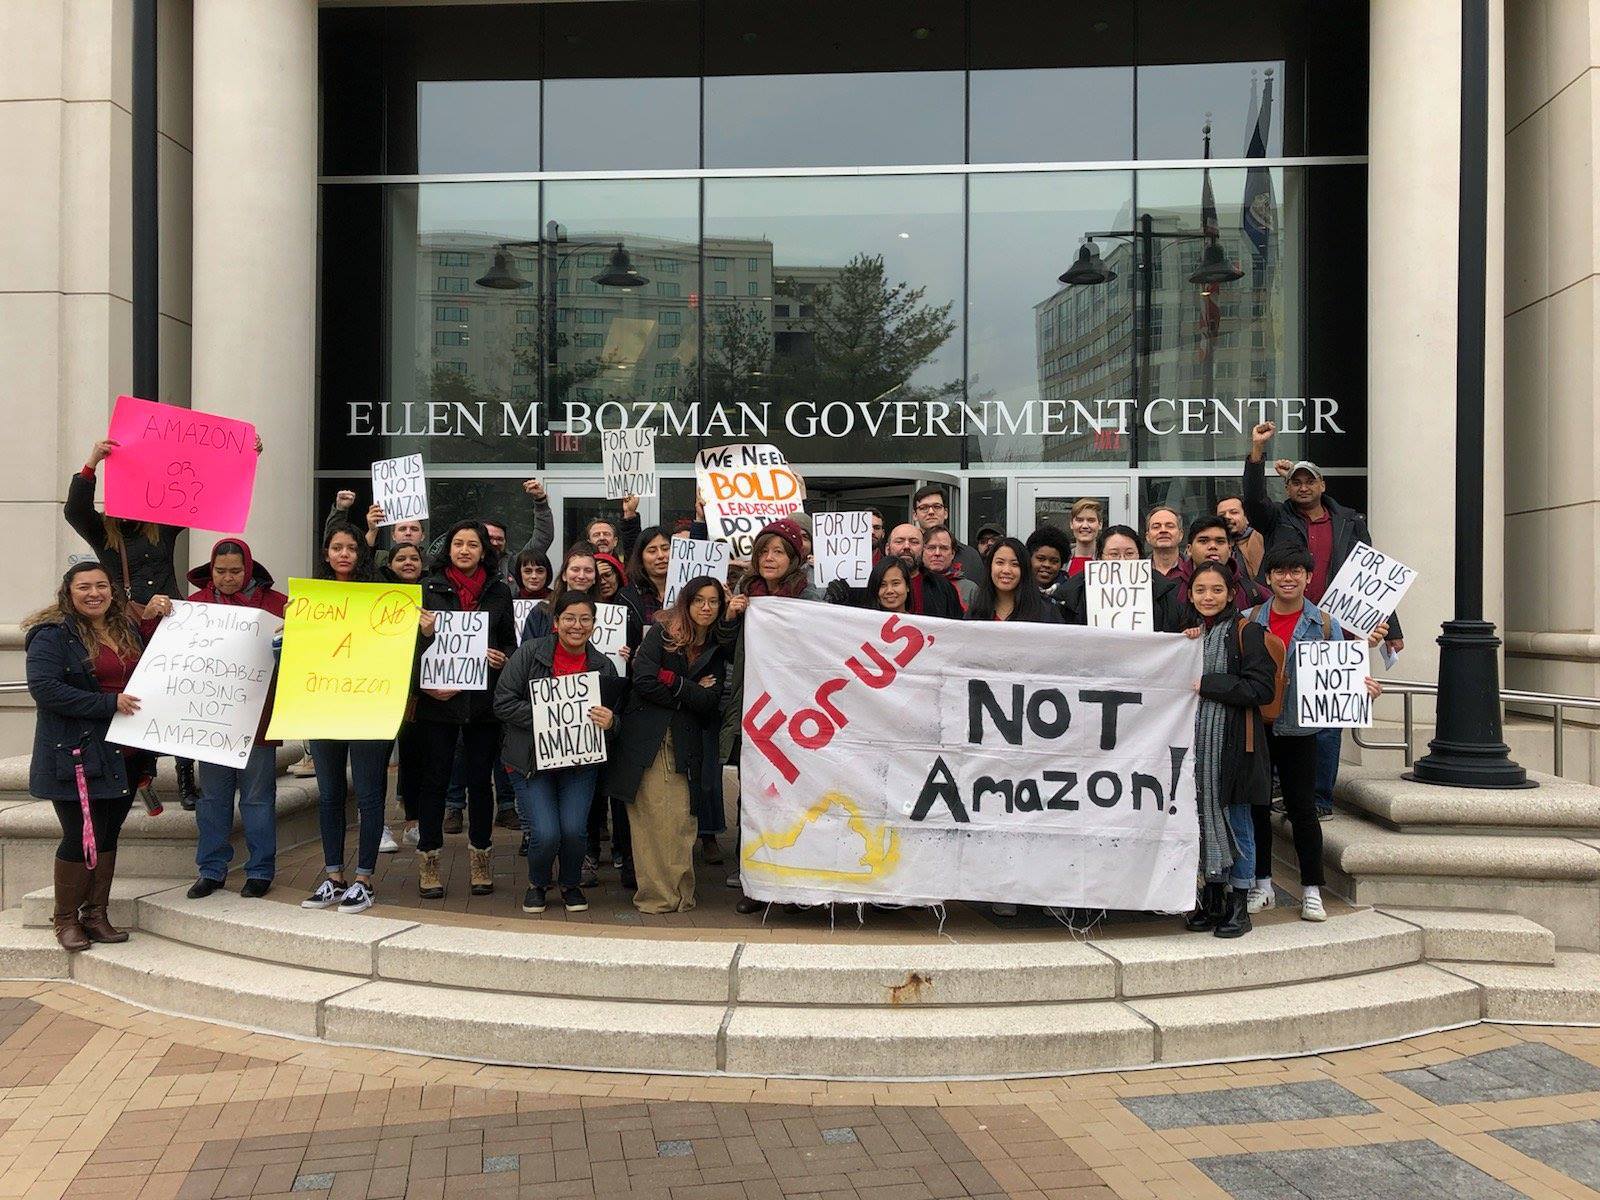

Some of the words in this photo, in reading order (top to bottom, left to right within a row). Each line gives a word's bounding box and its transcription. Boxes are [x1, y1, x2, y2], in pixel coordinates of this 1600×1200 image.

[346, 401, 487, 436] ELLEN
[500, 401, 550, 437] M.
[562, 401, 772, 437] BOZMAN
[785, 399, 1138, 437] GOVERNMENT
[1143, 397, 1346, 436] CENTER
[142, 415, 247, 454] AMAZON
[603, 430, 628, 451] FOR
[635, 430, 651, 448] US
[373, 460, 397, 481] FOR
[404, 455, 420, 475] US
[612, 451, 644, 473] NOT
[701, 447, 733, 469] WE
[146, 481, 204, 514] US?
[384, 477, 420, 496] NOT
[608, 473, 654, 498] AMAZON
[708, 469, 797, 501] BOLD
[717, 502, 798, 516] LEADERSHIP
[720, 517, 752, 537] DO
[815, 513, 844, 536] FOR
[851, 512, 869, 534] US
[672, 539, 696, 561] FOR
[705, 542, 723, 562] US
[826, 537, 864, 556] NOT
[1089, 562, 1122, 586] FOR
[1129, 561, 1149, 585] US
[1350, 545, 1385, 575] FOR
[1388, 564, 1411, 585] US
[1101, 587, 1145, 609] NOT
[1350, 571, 1397, 602] NOT
[295, 597, 349, 621] DIGAN
[604, 605, 624, 626] US
[1320, 588, 1389, 634] AMAZON
[431, 611, 454, 633] OR
[462, 612, 482, 632] US
[188, 633, 224, 649] for
[332, 632, 352, 659] A
[437, 634, 476, 655] NOT
[591, 626, 617, 645] OT
[1298, 642, 1331, 667] FOR
[1338, 641, 1364, 666] US
[305, 672, 391, 695] amazon
[422, 656, 488, 686] AMAZON
[1315, 668, 1356, 691] NOT
[166, 675, 247, 704] HOUSING
[531, 677, 561, 705] FOR
[565, 674, 589, 699] US
[188, 701, 234, 718] NOT
[548, 699, 588, 727] NOT
[968, 679, 1143, 750] NOT
[1301, 693, 1371, 724] AMAZON
[143, 718, 251, 758] AMAZON!
[538, 722, 603, 760] AMAZON
[742, 678, 850, 785] For
[910, 746, 1189, 823] Amazon!
